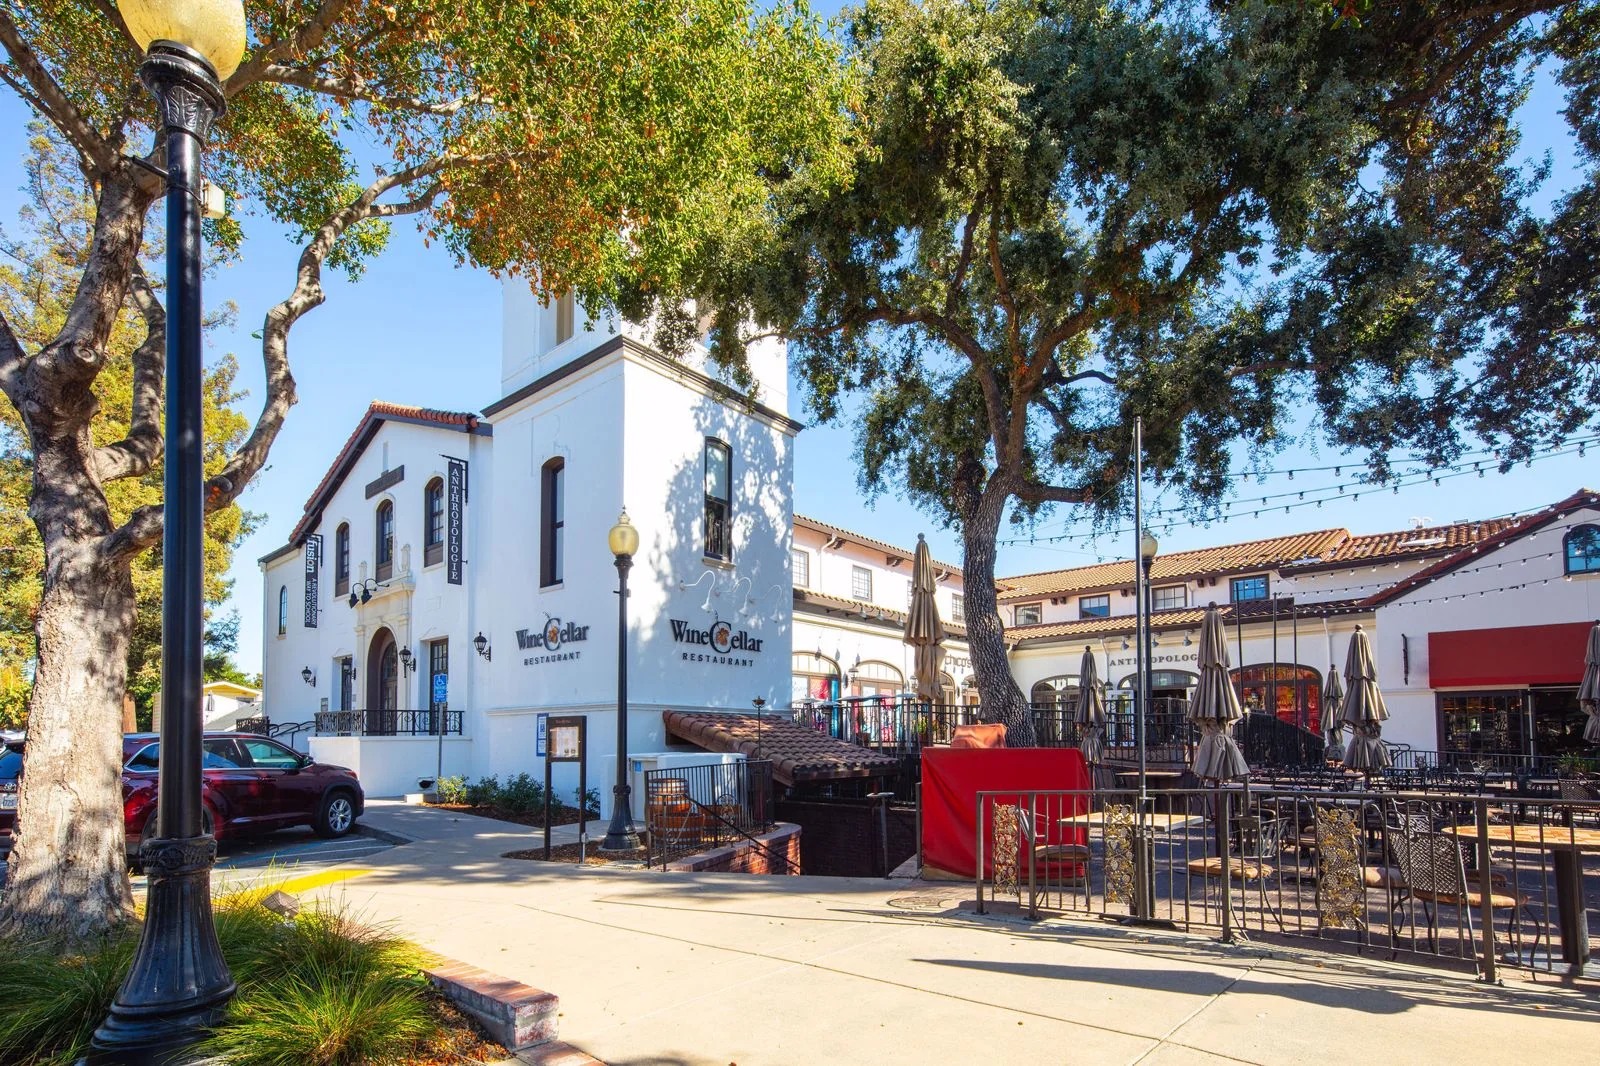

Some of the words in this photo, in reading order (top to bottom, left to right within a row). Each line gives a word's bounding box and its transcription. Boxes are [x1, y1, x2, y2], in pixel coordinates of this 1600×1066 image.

[451, 468, 459, 580] ANTHROPOLOGIE
[307, 539, 318, 573] fusion
[524, 651, 581, 666] RESTAURANT
[682, 652, 754, 667] RESTAURANT
[1109, 653, 1198, 667] ANTOPOLOG
